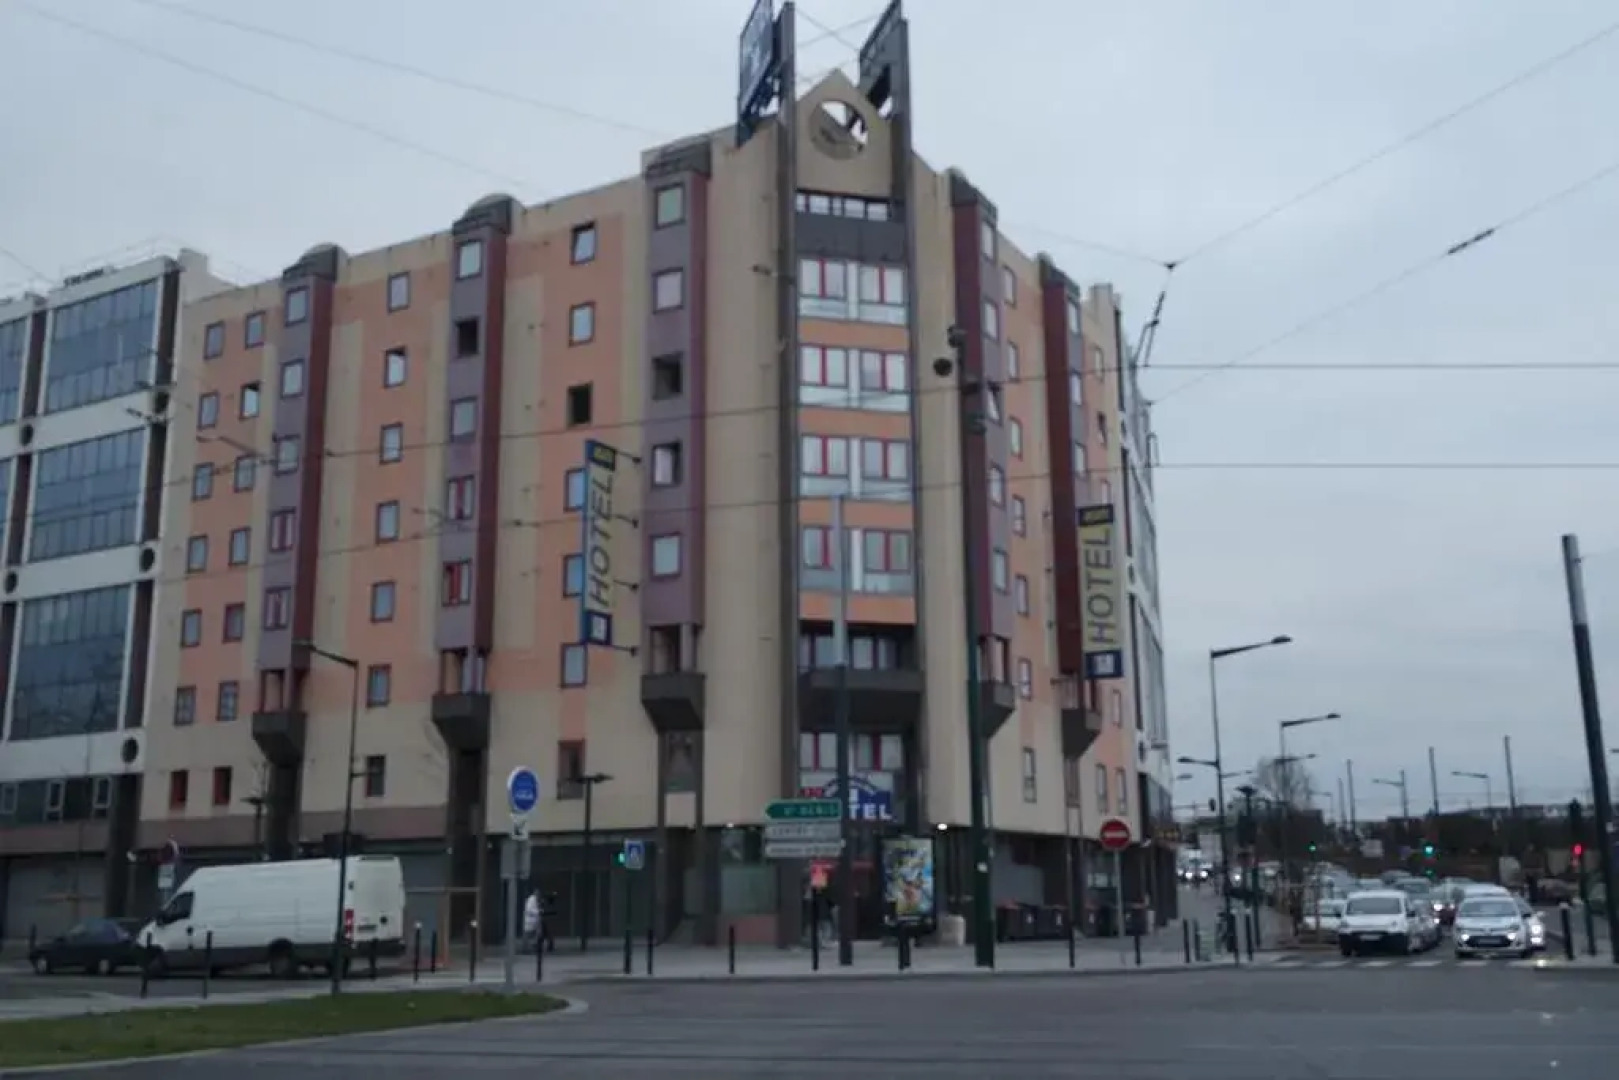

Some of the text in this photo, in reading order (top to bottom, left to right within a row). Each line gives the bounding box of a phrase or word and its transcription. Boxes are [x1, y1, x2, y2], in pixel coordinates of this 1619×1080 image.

[590, 475, 613, 608] HOTEL
[1084, 529, 1116, 645] HOTEL
[848, 803, 892, 820] TEL
